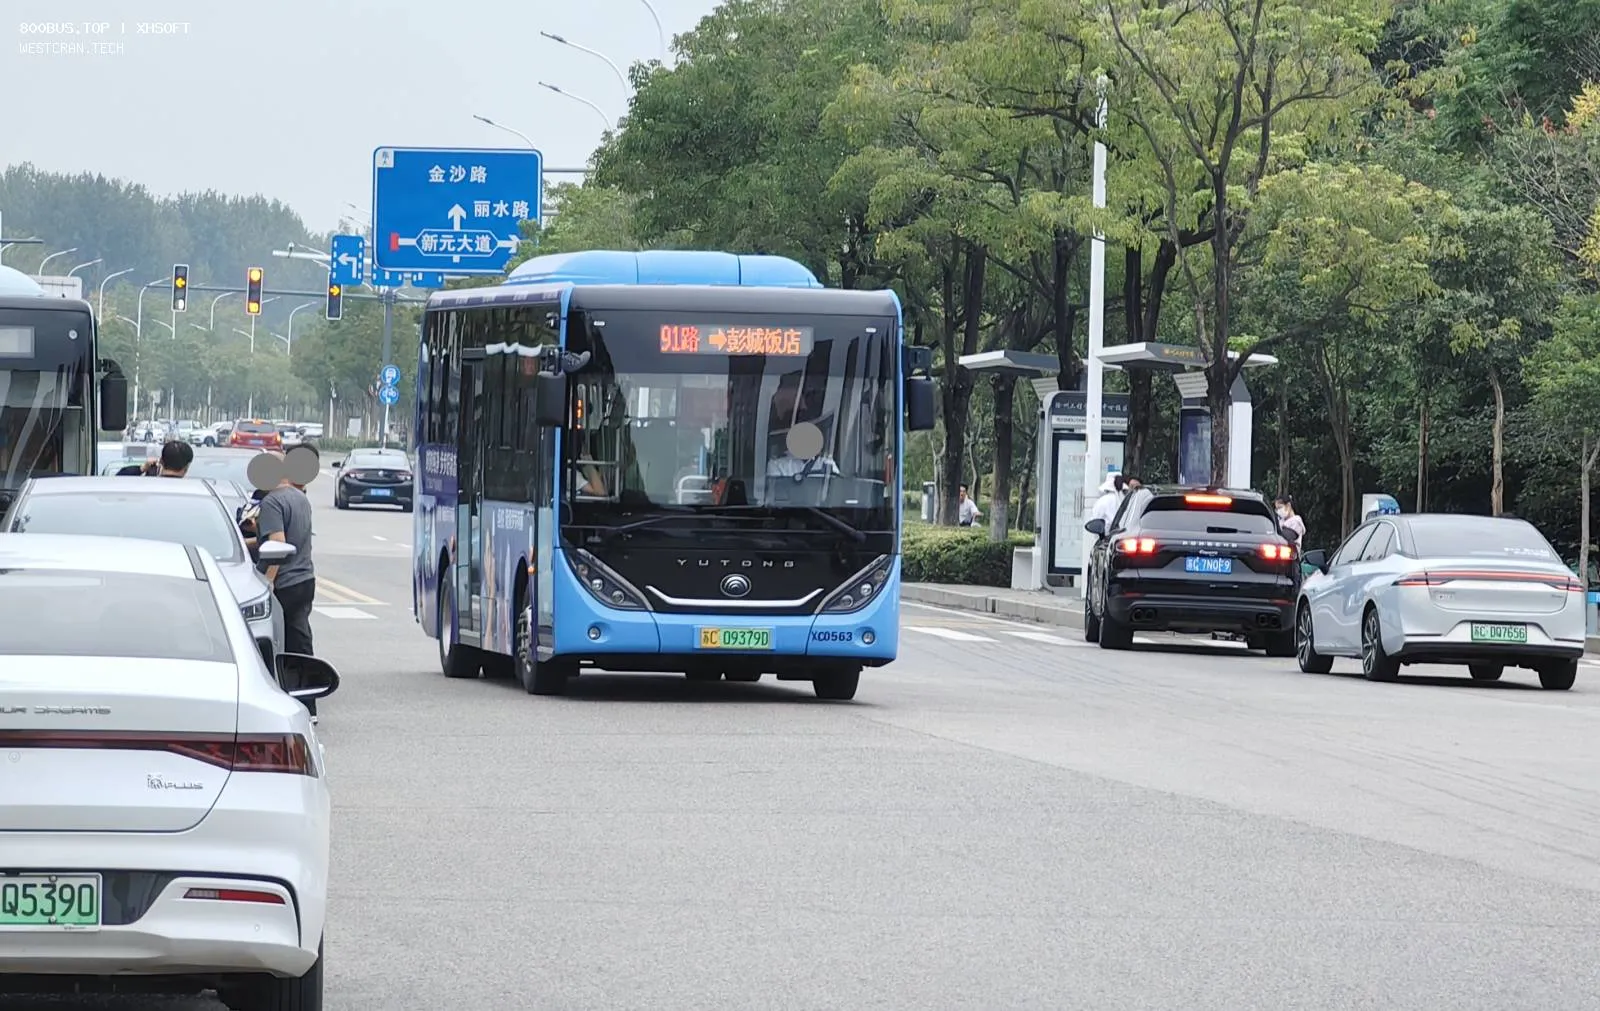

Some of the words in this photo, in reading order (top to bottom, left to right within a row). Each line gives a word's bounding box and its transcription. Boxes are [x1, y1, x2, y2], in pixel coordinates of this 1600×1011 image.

[428, 165, 487, 183] 金沙路
[474, 200, 529, 219] 丽水路
[421, 234, 492, 253] 新元大道
[661, 325, 700, 352] 91路
[726, 328, 802, 354] 彭城饭店
[677, 559, 795, 568] YUTONG
[723, 630, 769, 646] 09379D
[811, 631, 853, 642] XC0563
[2, 883, 94, 916] Q5390
